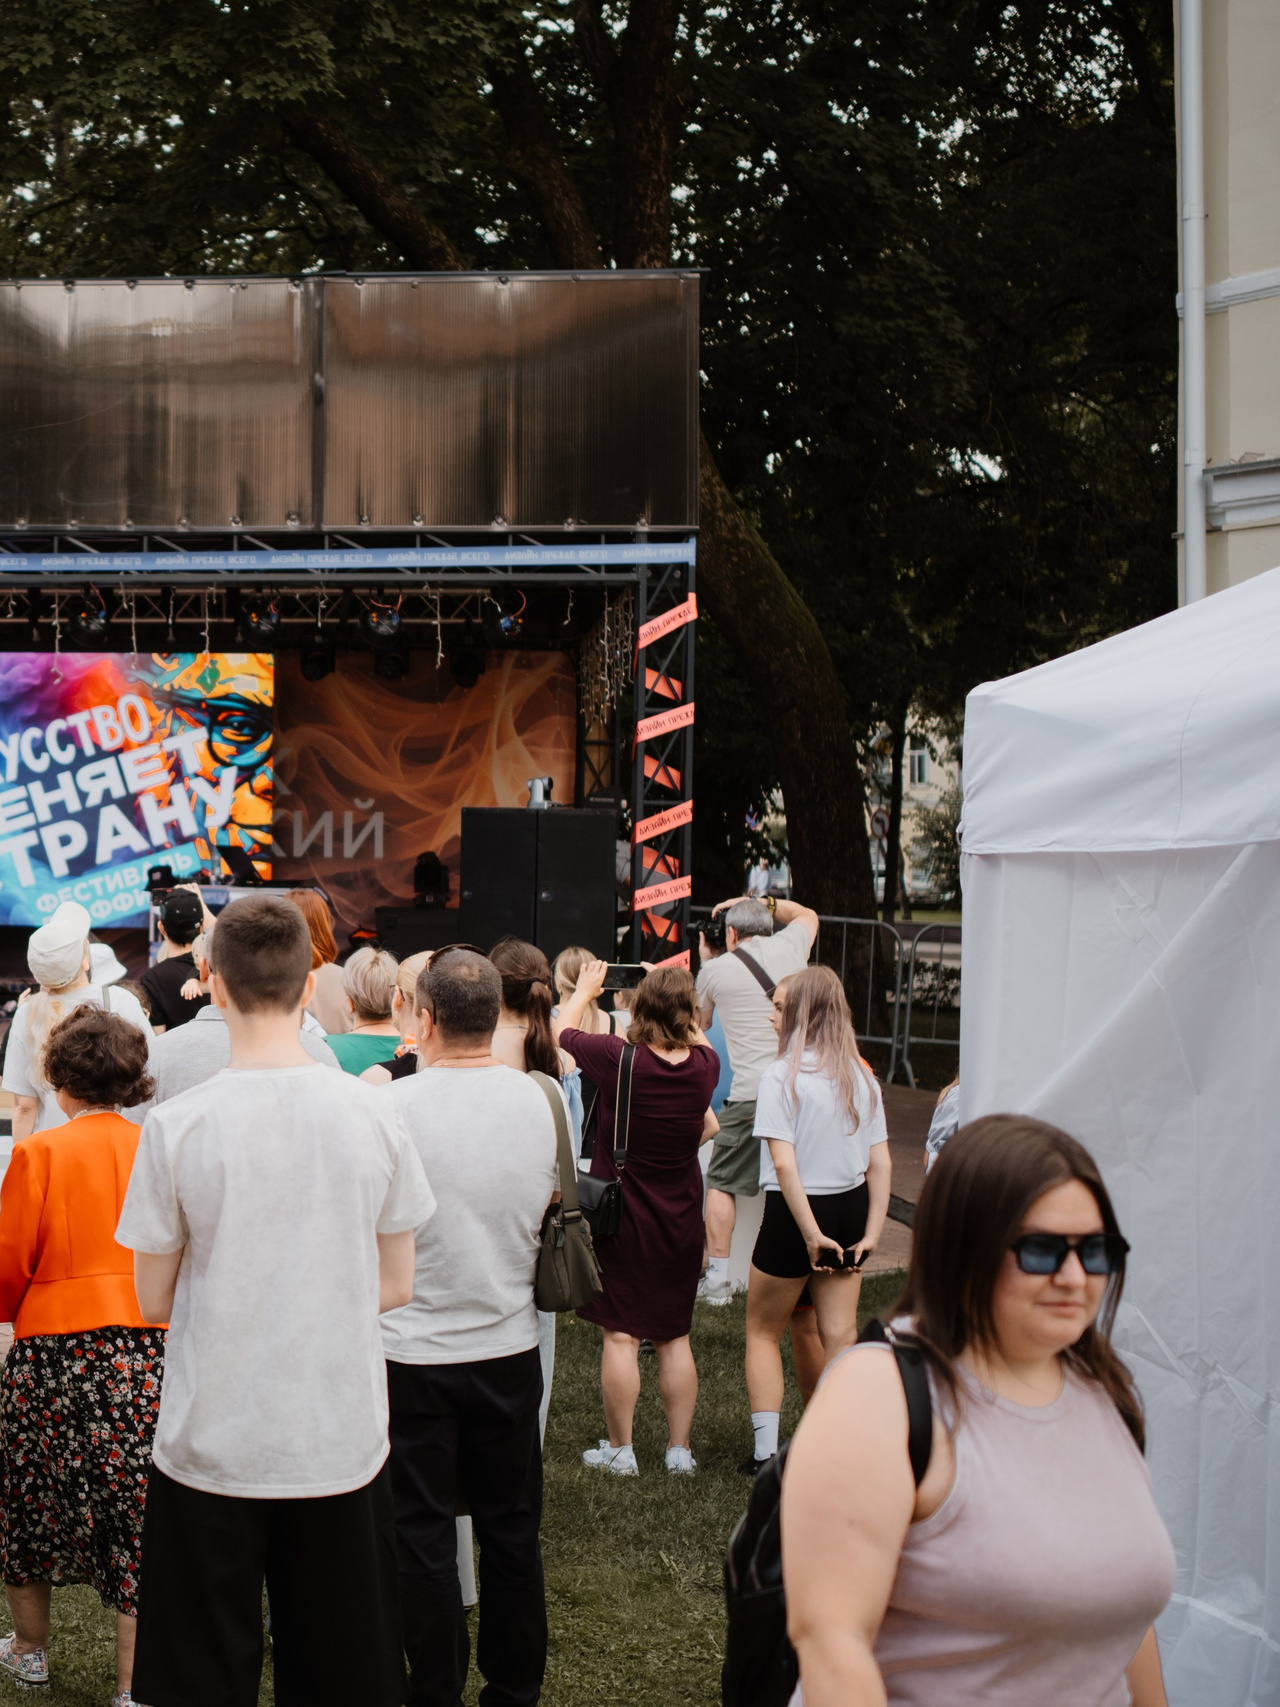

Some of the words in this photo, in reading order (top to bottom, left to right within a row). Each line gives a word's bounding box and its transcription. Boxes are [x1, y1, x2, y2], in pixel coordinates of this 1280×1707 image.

[638, 624, 660, 642] ЗАЙН
[670, 709, 694, 726] ПРЕЖ
[639, 816, 670, 836] ДИЗАЙН
[670, 882, 692, 895] ПРЕЖ
